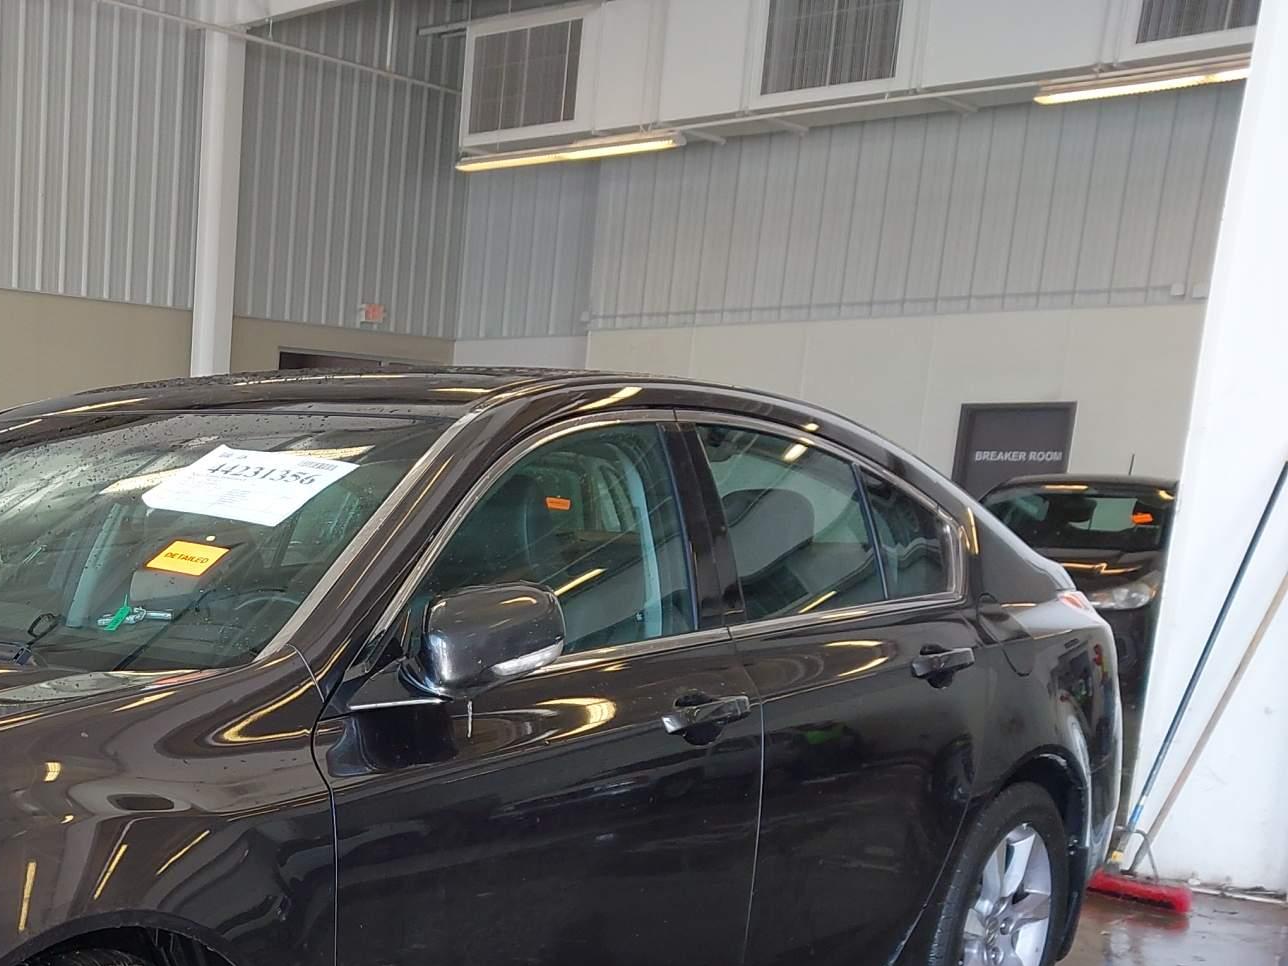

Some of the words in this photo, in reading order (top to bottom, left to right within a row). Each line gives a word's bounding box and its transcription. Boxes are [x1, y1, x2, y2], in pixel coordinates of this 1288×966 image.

[975, 451, 1026, 461] BREAKER
[1029, 451, 1063, 461] ROOM
[207, 463, 322, 485] 44231356
[164, 551, 209, 564] DETAILED
